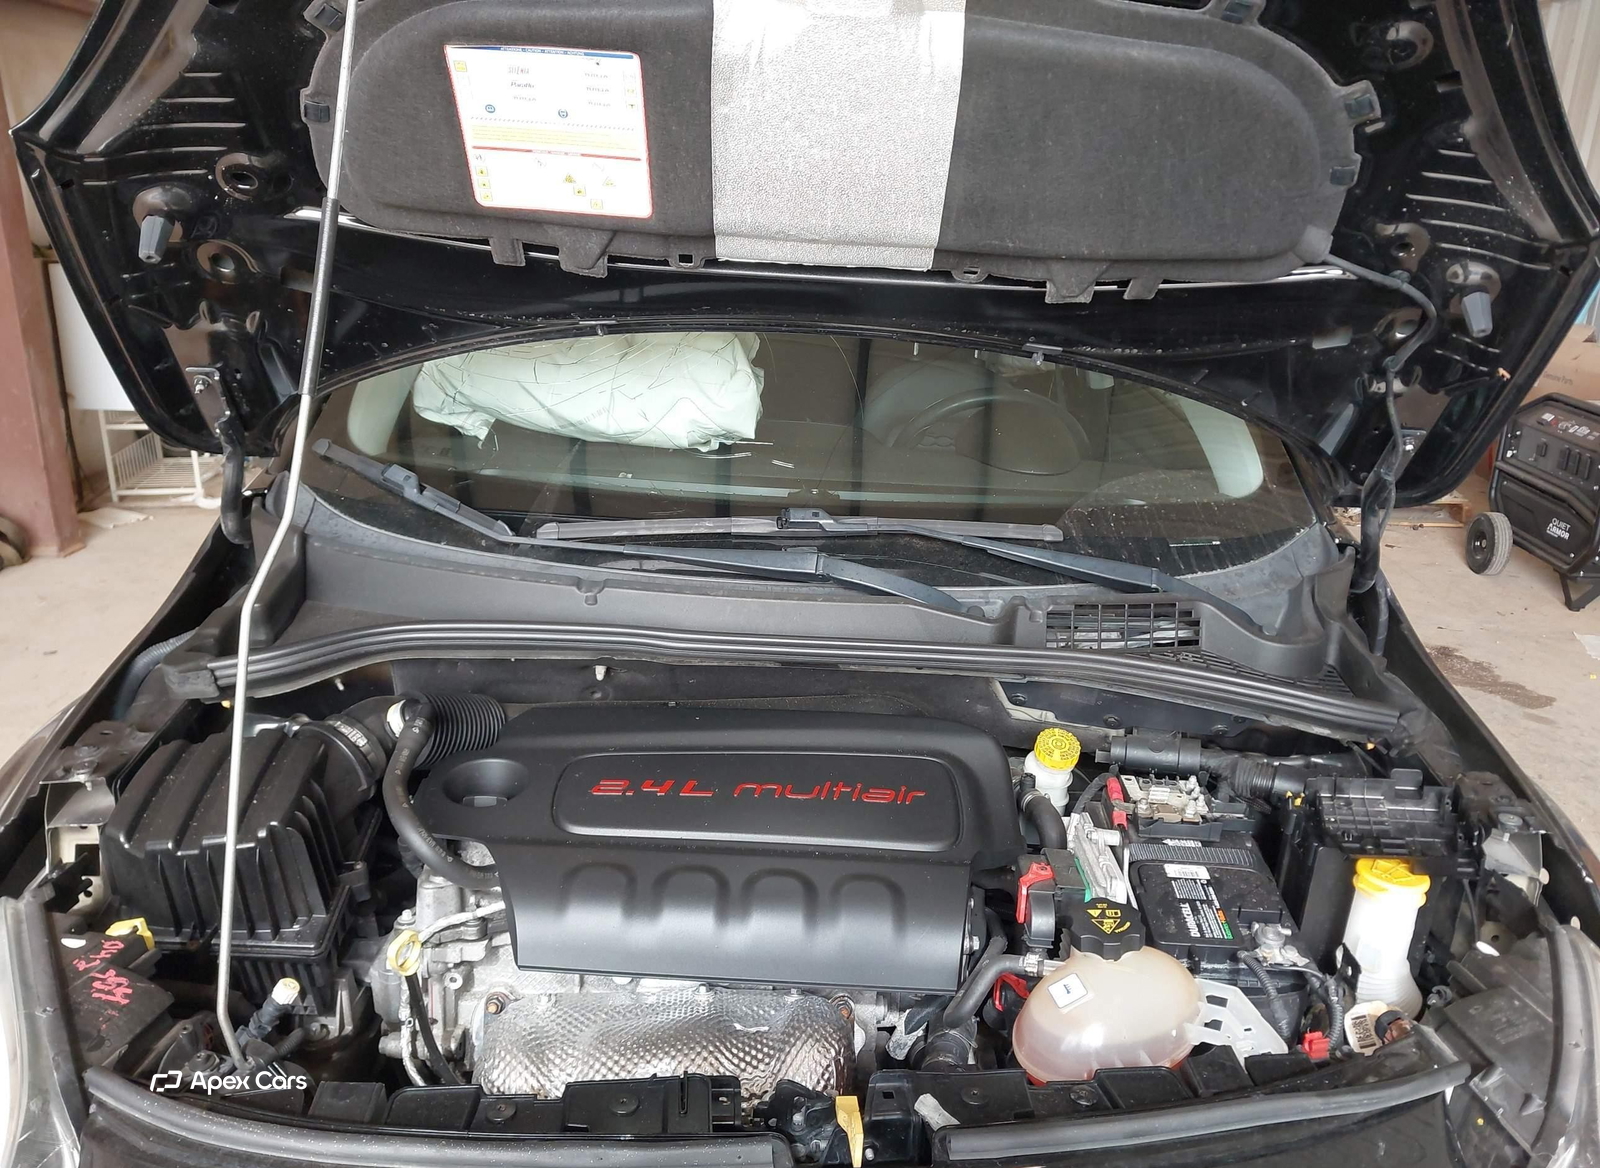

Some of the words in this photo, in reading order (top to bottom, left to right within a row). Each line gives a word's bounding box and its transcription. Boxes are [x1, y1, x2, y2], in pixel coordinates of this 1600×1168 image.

[1546, 523, 1570, 540] ARMOR
[1551, 517, 1571, 531] QUIET
[733, 781, 926, 804] multiair
[1179, 902, 1201, 938] DURACELL
